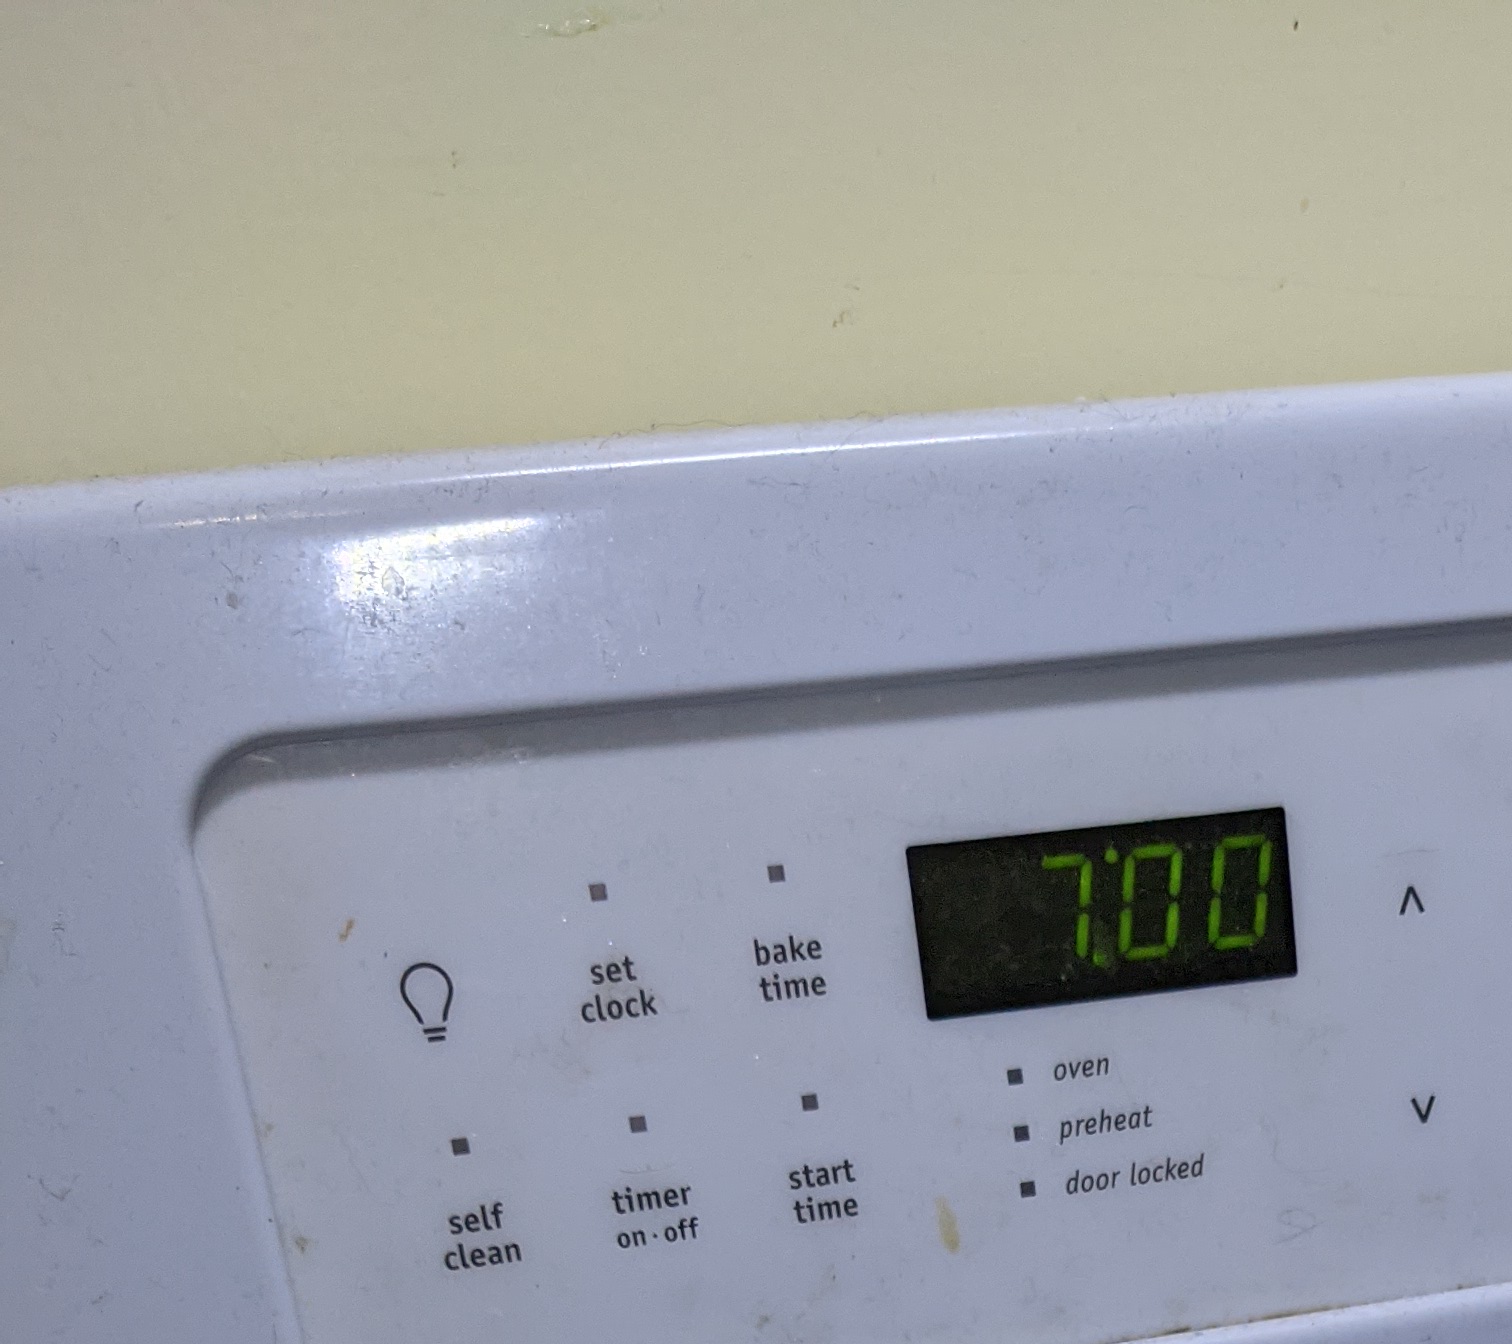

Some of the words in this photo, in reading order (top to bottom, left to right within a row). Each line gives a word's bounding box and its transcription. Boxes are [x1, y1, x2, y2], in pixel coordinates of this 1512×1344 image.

[1041, 834, 1272, 966] 7:00
[753, 934, 822, 967] bake
[590, 955, 637, 986] set
[758, 973, 827, 1002] time
[581, 989, 658, 1023] clock
[1053, 1057, 1110, 1082] oven
[1059, 1105, 1153, 1144] preheat
[788, 1159, 856, 1190] start
[1065, 1169, 1121, 1195] door
[1130, 1152, 1205, 1187] locked
[611, 1186, 691, 1215] timer
[792, 1196, 859, 1224] time
[448, 1201, 504, 1235] self
[616, 1229, 647, 1249] on
[664, 1216, 699, 1243] off
[443, 1242, 522, 1271] clean
